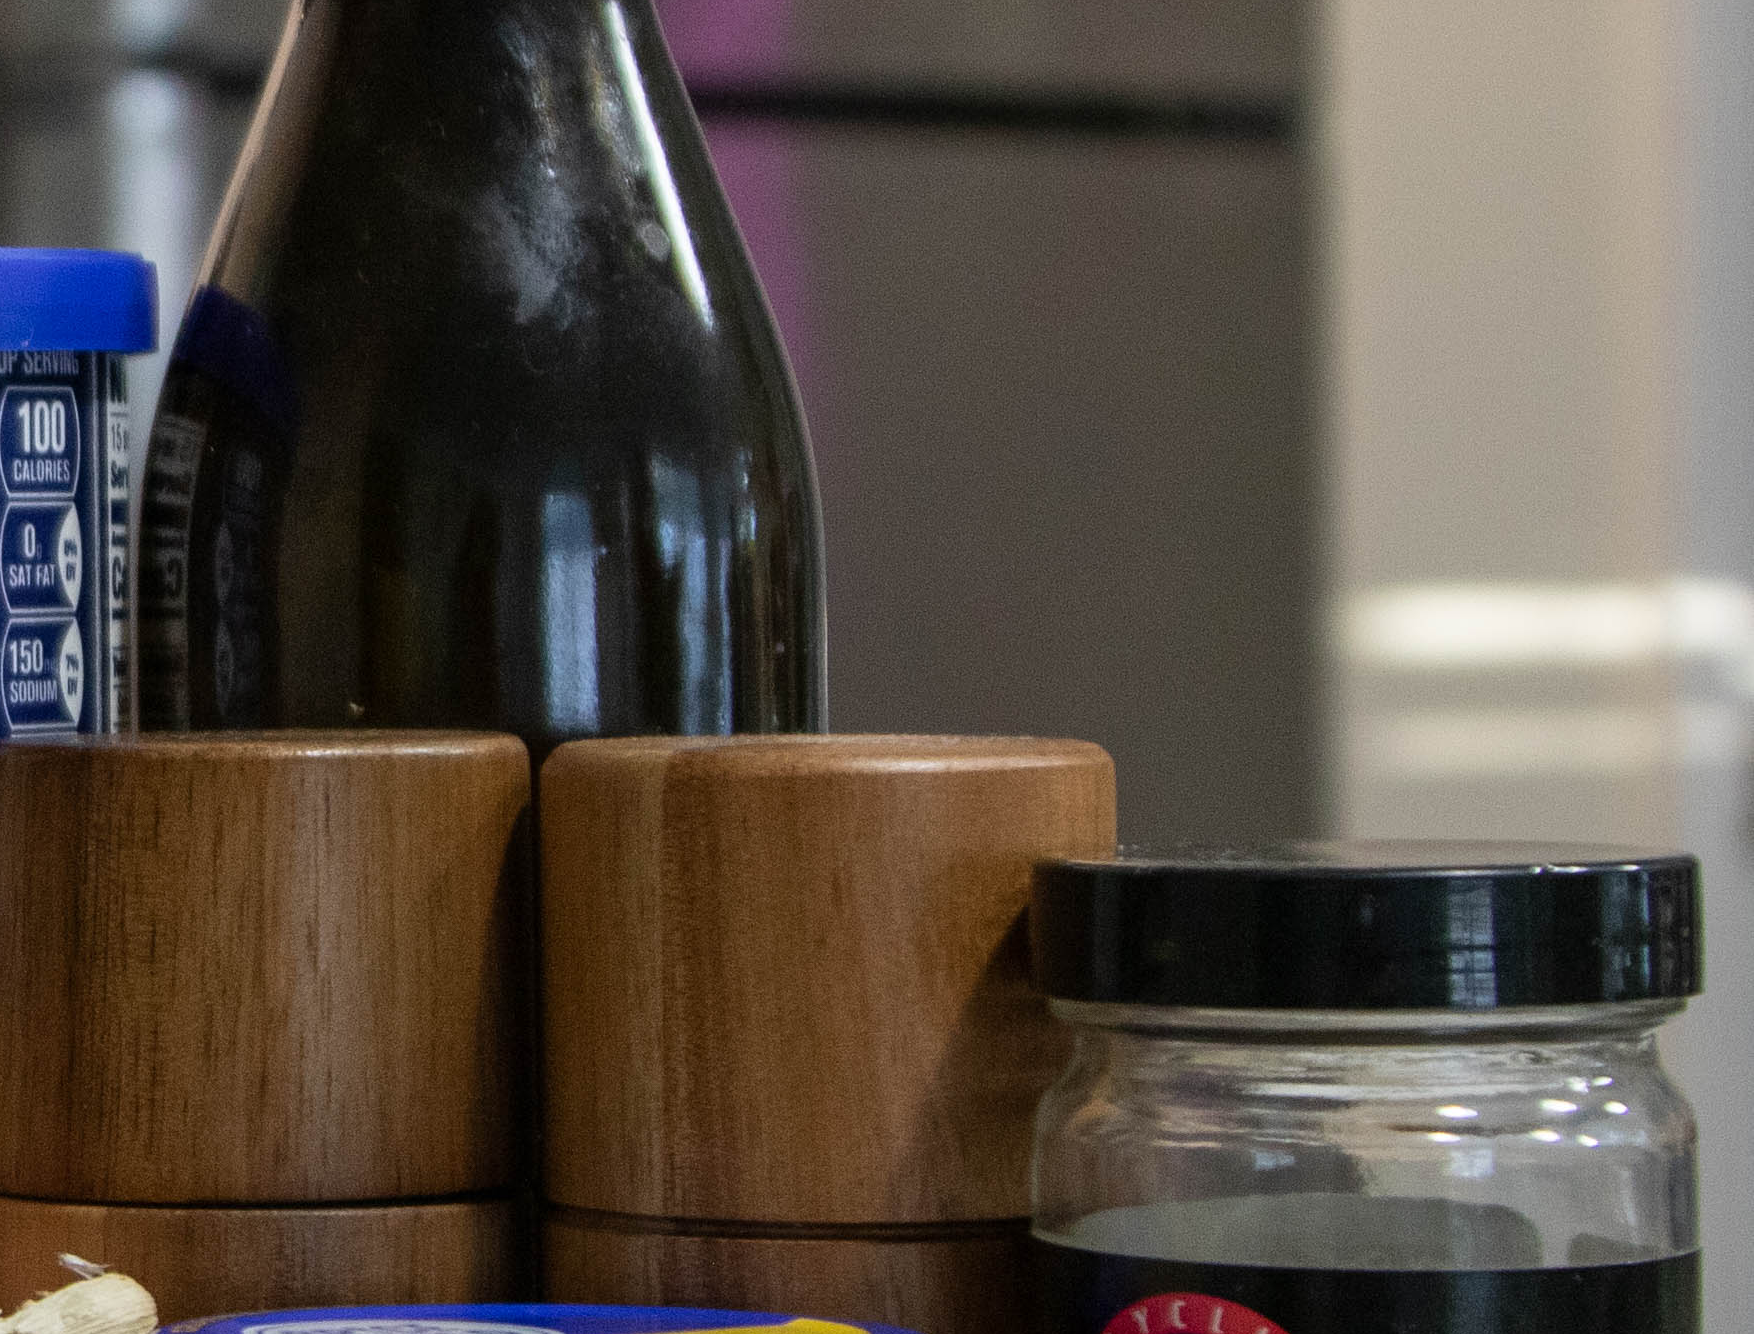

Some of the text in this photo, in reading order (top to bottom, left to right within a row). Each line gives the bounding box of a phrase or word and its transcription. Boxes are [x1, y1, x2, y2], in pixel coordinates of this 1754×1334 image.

[18, 399, 66, 455] 100
[13, 458, 71, 483] CALORIES
[9, 563, 56, 587] SAT FAT
[10, 679, 59, 704] SODIUM
